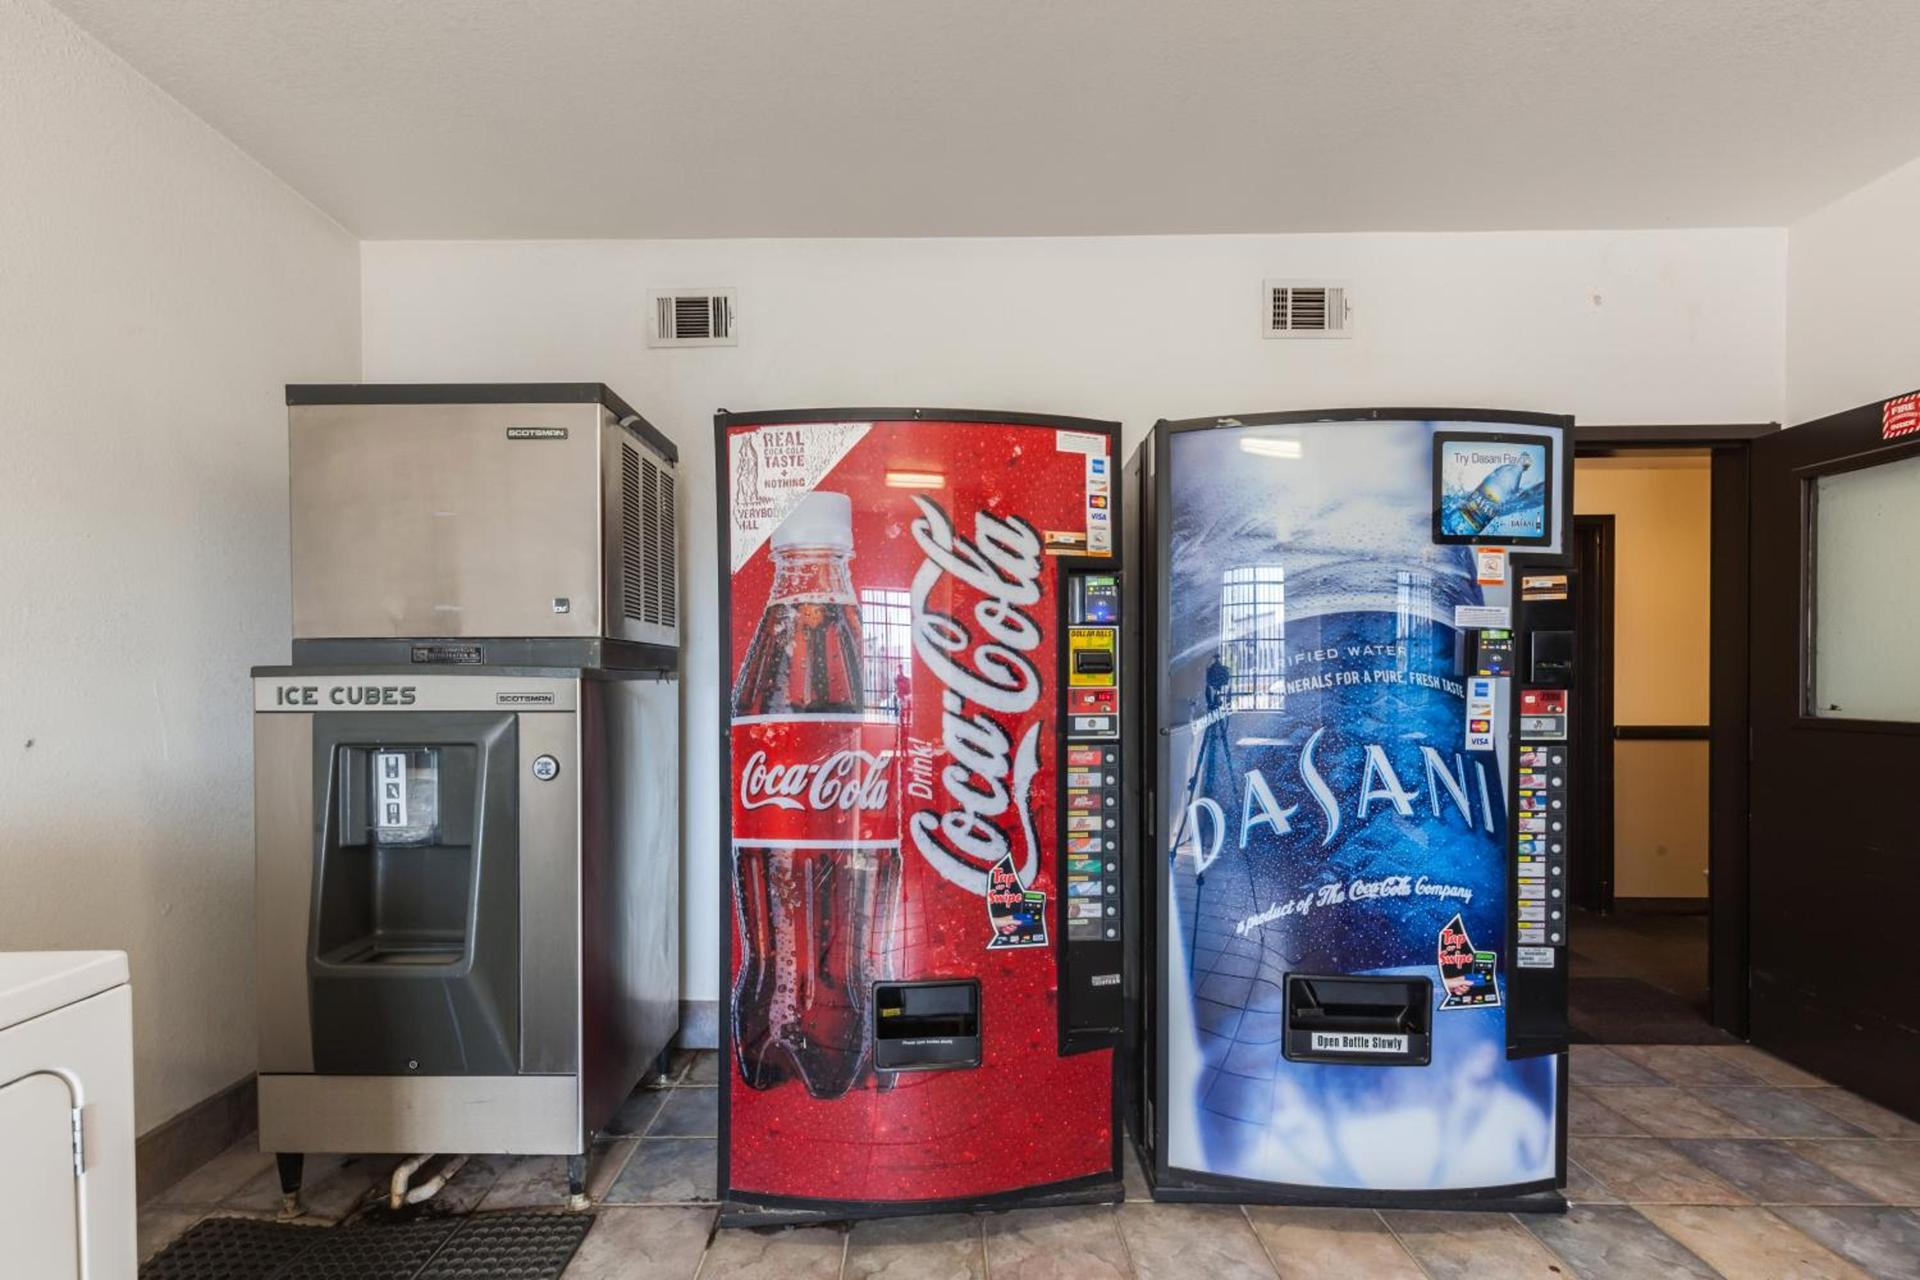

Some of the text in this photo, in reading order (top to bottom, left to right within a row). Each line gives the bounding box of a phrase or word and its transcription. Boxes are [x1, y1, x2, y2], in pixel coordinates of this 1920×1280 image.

[1891, 402, 1915, 415] FIRE
[763, 431, 805, 447] REAL
[764, 454, 805, 468] TASTE
[1454, 452, 1469, 465] Try
[1472, 452, 1501, 464] Dasani
[764, 478, 805, 489] NOTHING
[1091, 512, 1107, 521] VISA
[1347, 645, 1408, 657] WATER
[1335, 672, 1361, 685] FOR
[1363, 670, 1372, 683] A
[1409, 672, 1440, 688] FRESH
[276, 686, 416, 705] ICE CUBES
[741, 750, 890, 811] Coca-Cola
[1187, 726, 1494, 874] DASANI
[993, 867, 1016, 888] Tap
[988, 889, 1022, 908] Swipe
[1246, 902, 1295, 936] product
[1296, 893, 1314, 916] of
[1316, 880, 1345, 907] The
[1415, 875, 1474, 904] Company
[1443, 928, 1465, 949] Tap
[1440, 950, 1473, 969] Swipe
[1317, 1035, 1402, 1051] Open Bottle Slowly
